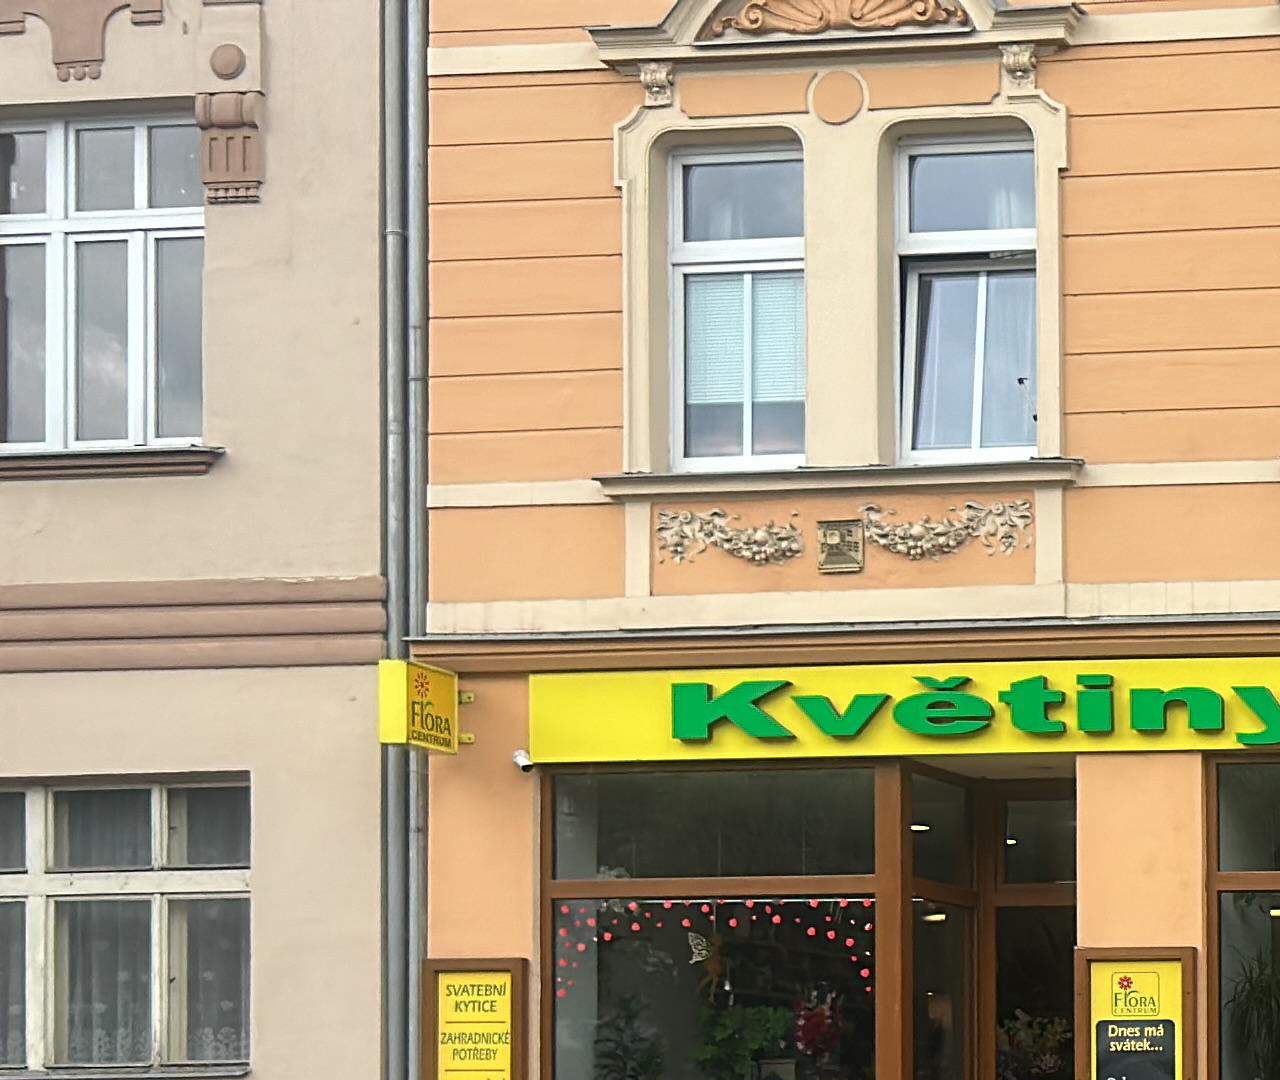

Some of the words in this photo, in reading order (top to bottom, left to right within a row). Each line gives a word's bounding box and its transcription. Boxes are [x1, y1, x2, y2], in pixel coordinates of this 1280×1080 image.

[411, 730, 452, 748] CENTRUM
[446, 982, 507, 997] SVATEBNÍ
[454, 1000, 497, 1012] KYTICE
[441, 1030, 510, 1044] ZAHRADNICKÉ
[1108, 1025, 1140, 1037] Dnes
[1144, 1024, 1164, 1037] má
[1109, 1038, 1163, 1051] svátek...
[453, 1047, 498, 1061] POTŘEBY
